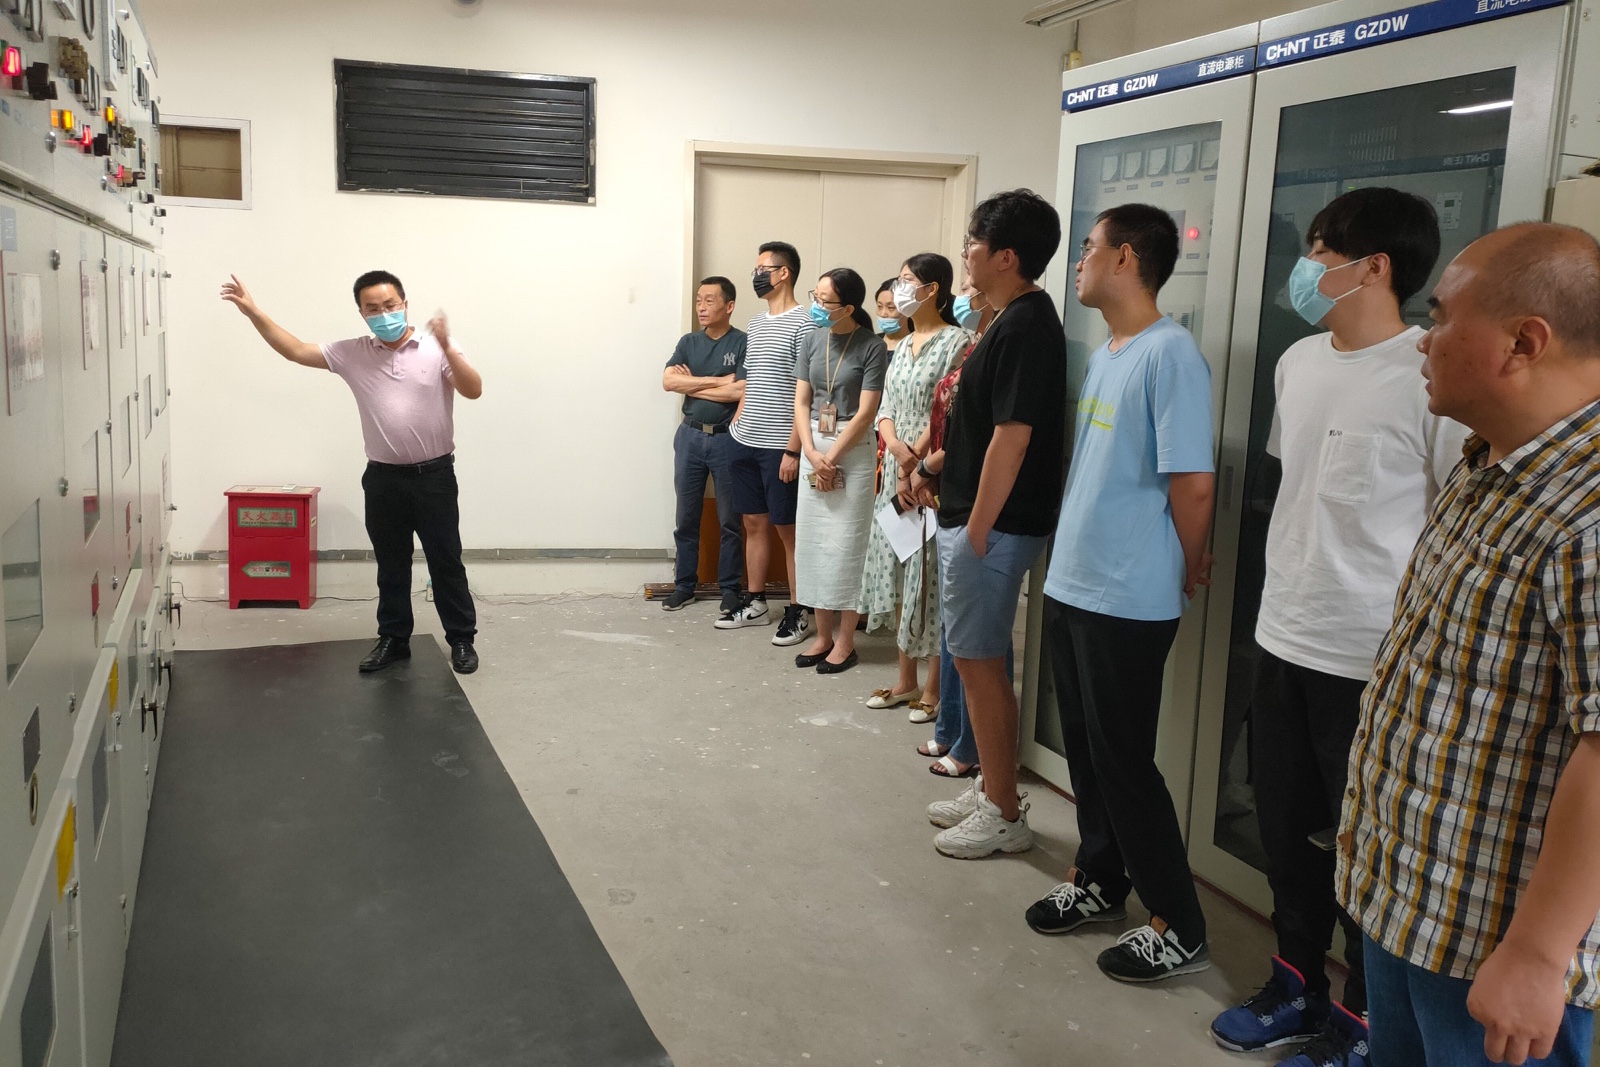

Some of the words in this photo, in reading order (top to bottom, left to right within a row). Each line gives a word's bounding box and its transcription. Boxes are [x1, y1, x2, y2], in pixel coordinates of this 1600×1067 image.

[1313, 29, 1346, 51] 正泰
[1354, 13, 1410, 41] GZDW
[1197, 54, 1245, 78] 直流电源柜
[1096, 82, 1119, 99] 正泰
[1123, 73, 1159, 93] GZDW
